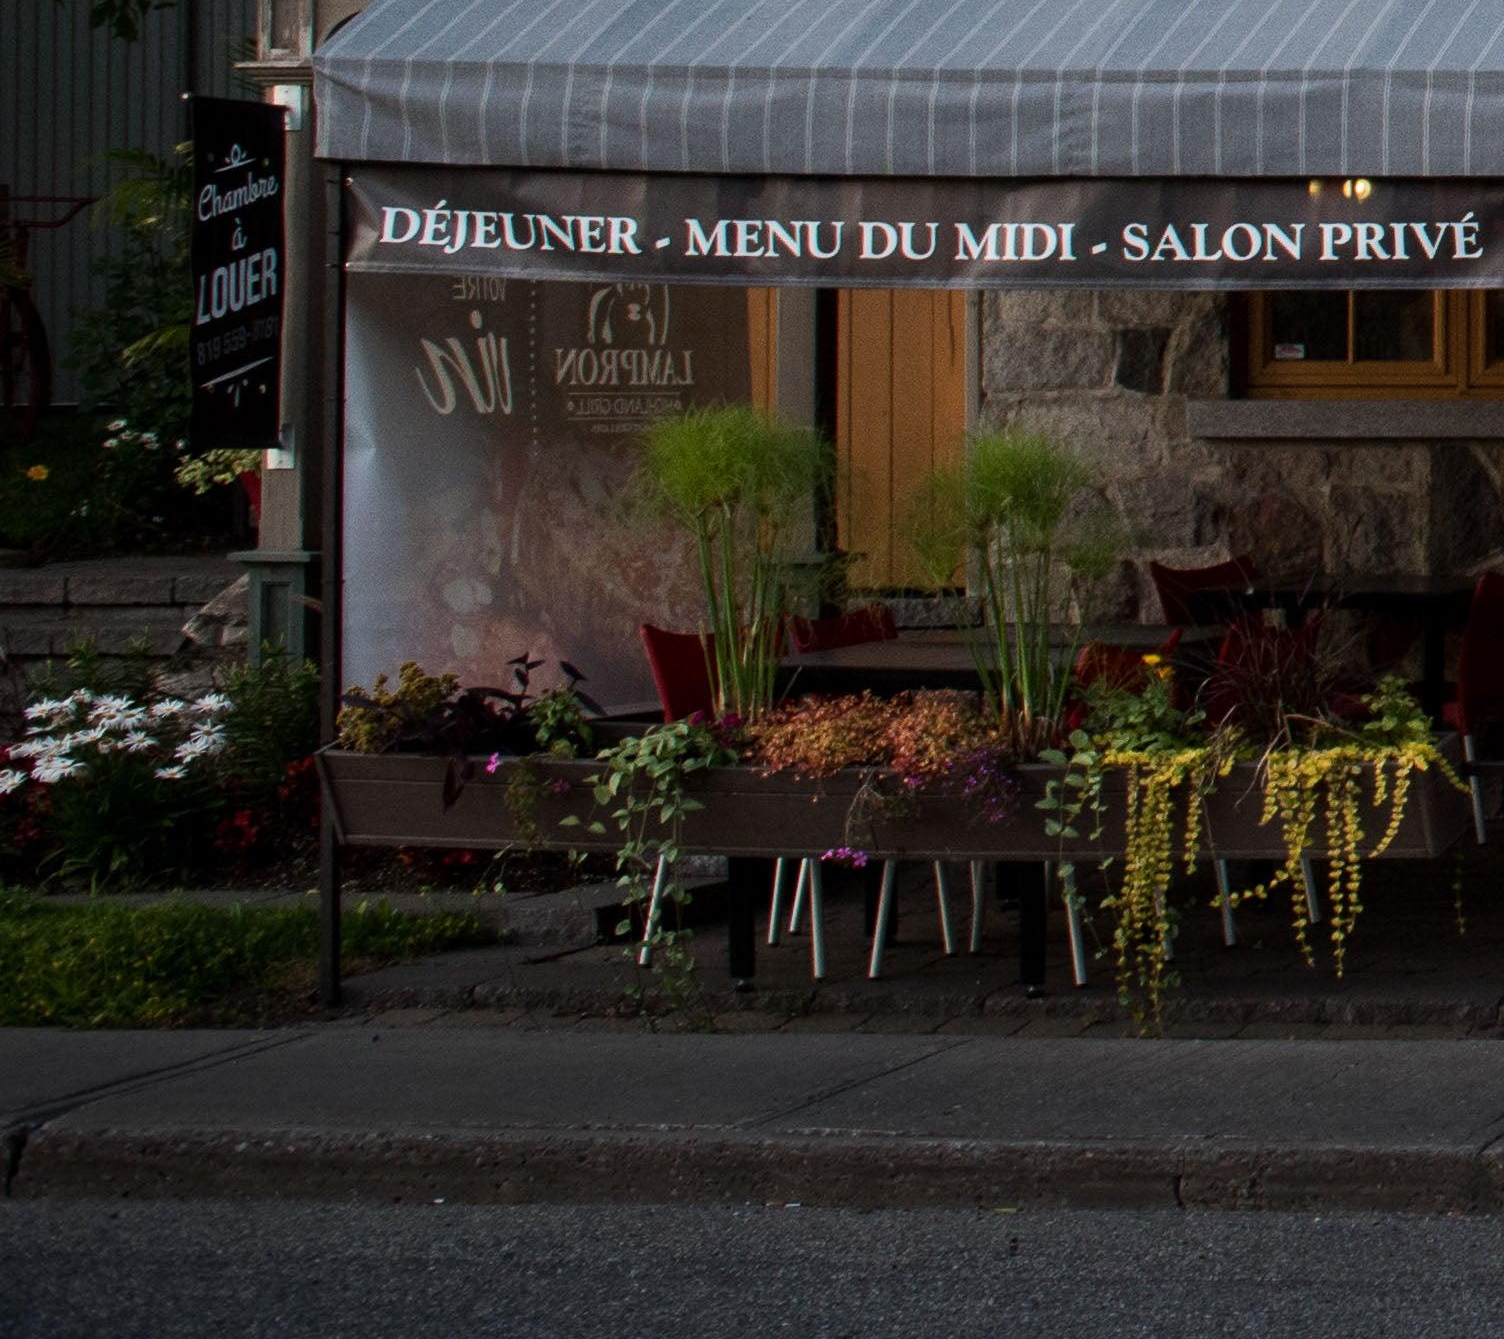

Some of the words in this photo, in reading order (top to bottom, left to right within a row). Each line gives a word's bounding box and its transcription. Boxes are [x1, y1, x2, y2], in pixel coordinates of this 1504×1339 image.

[198, 171, 278, 222] Chambre
[232, 218, 247, 250] à
[379, 199, 643, 255] DÉJEUNER
[685, 218, 845, 260] MENU
[858, 221, 940, 261] DU
[954, 222, 1078, 262] MIDI
[1122, 222, 1307, 262] SALON
[1317, 211, 1484, 262] PRIVÉ
[196, 246, 278, 326] LOUER
